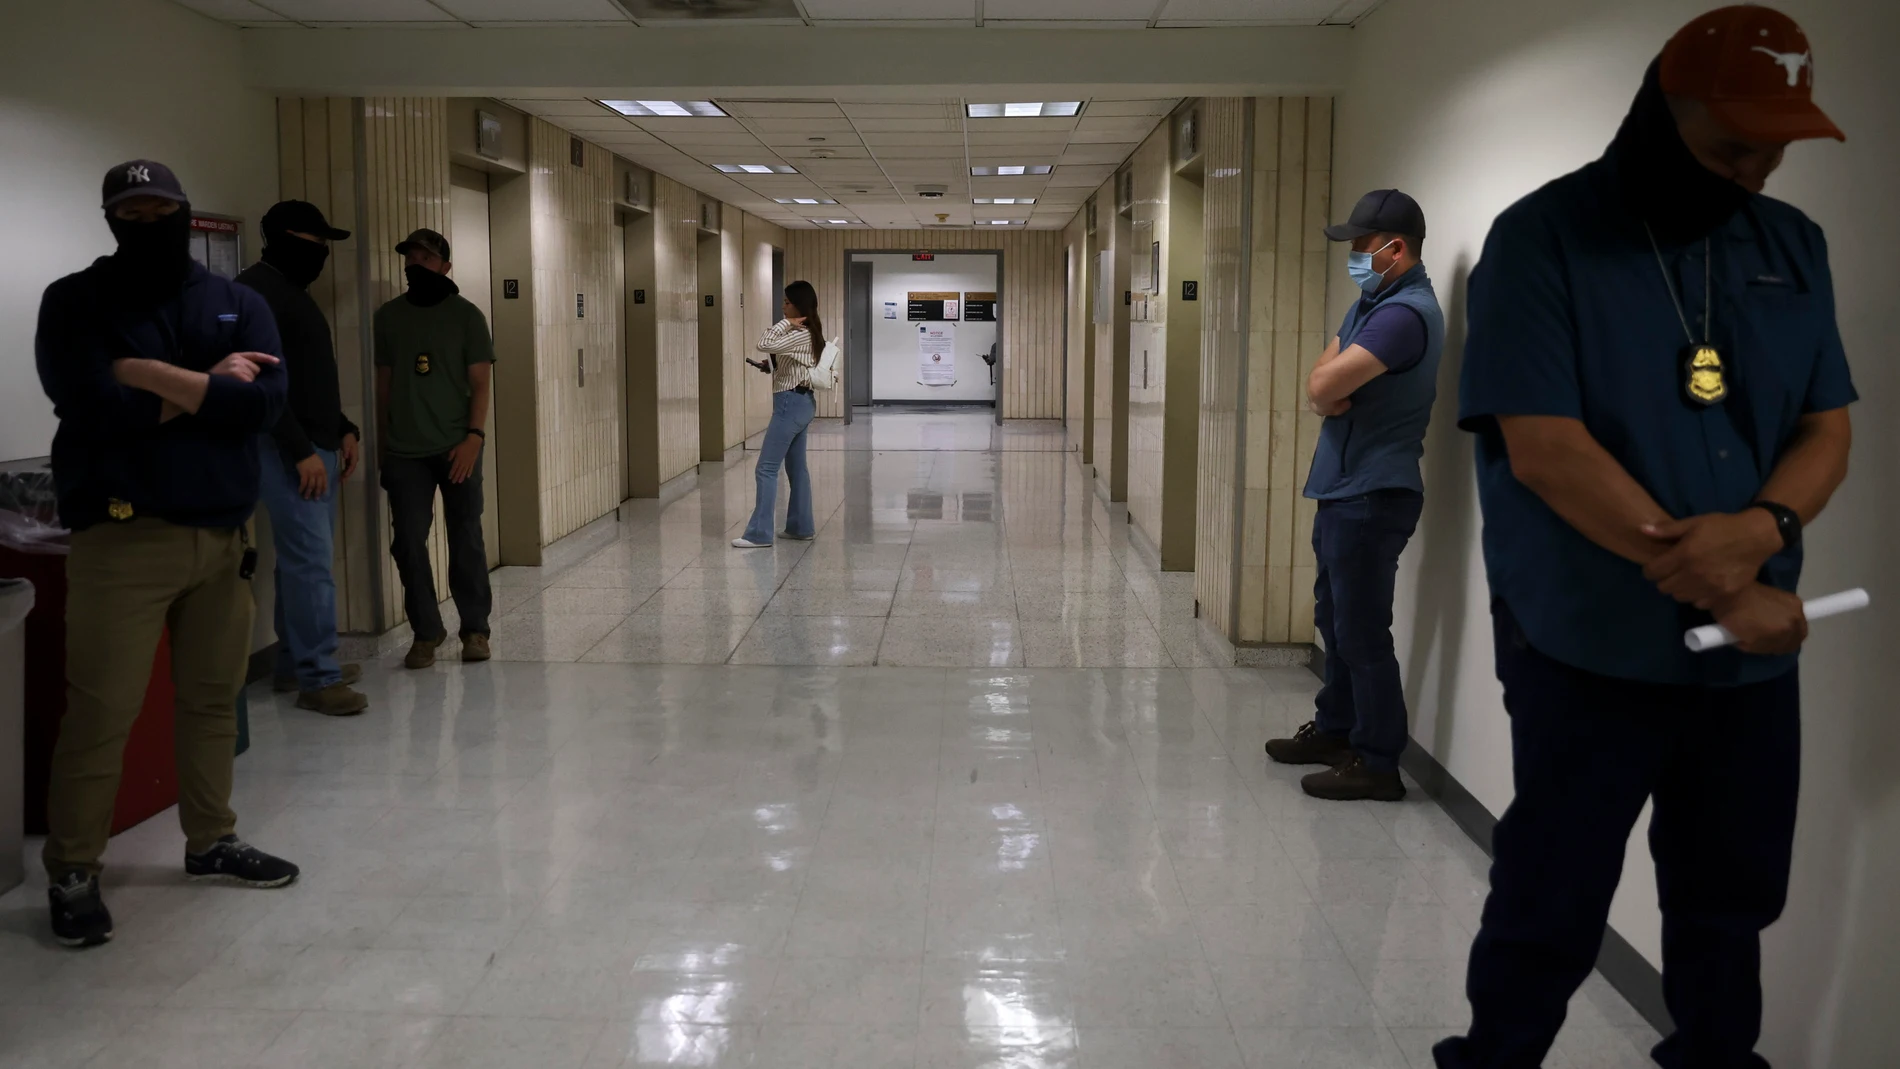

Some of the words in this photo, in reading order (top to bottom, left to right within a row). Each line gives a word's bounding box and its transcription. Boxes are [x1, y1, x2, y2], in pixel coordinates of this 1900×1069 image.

[127, 165, 150, 183] NY
[506, 280, 516, 294] 12
[1184, 282, 1195, 296] 12
[635, 290, 643, 300] 12
